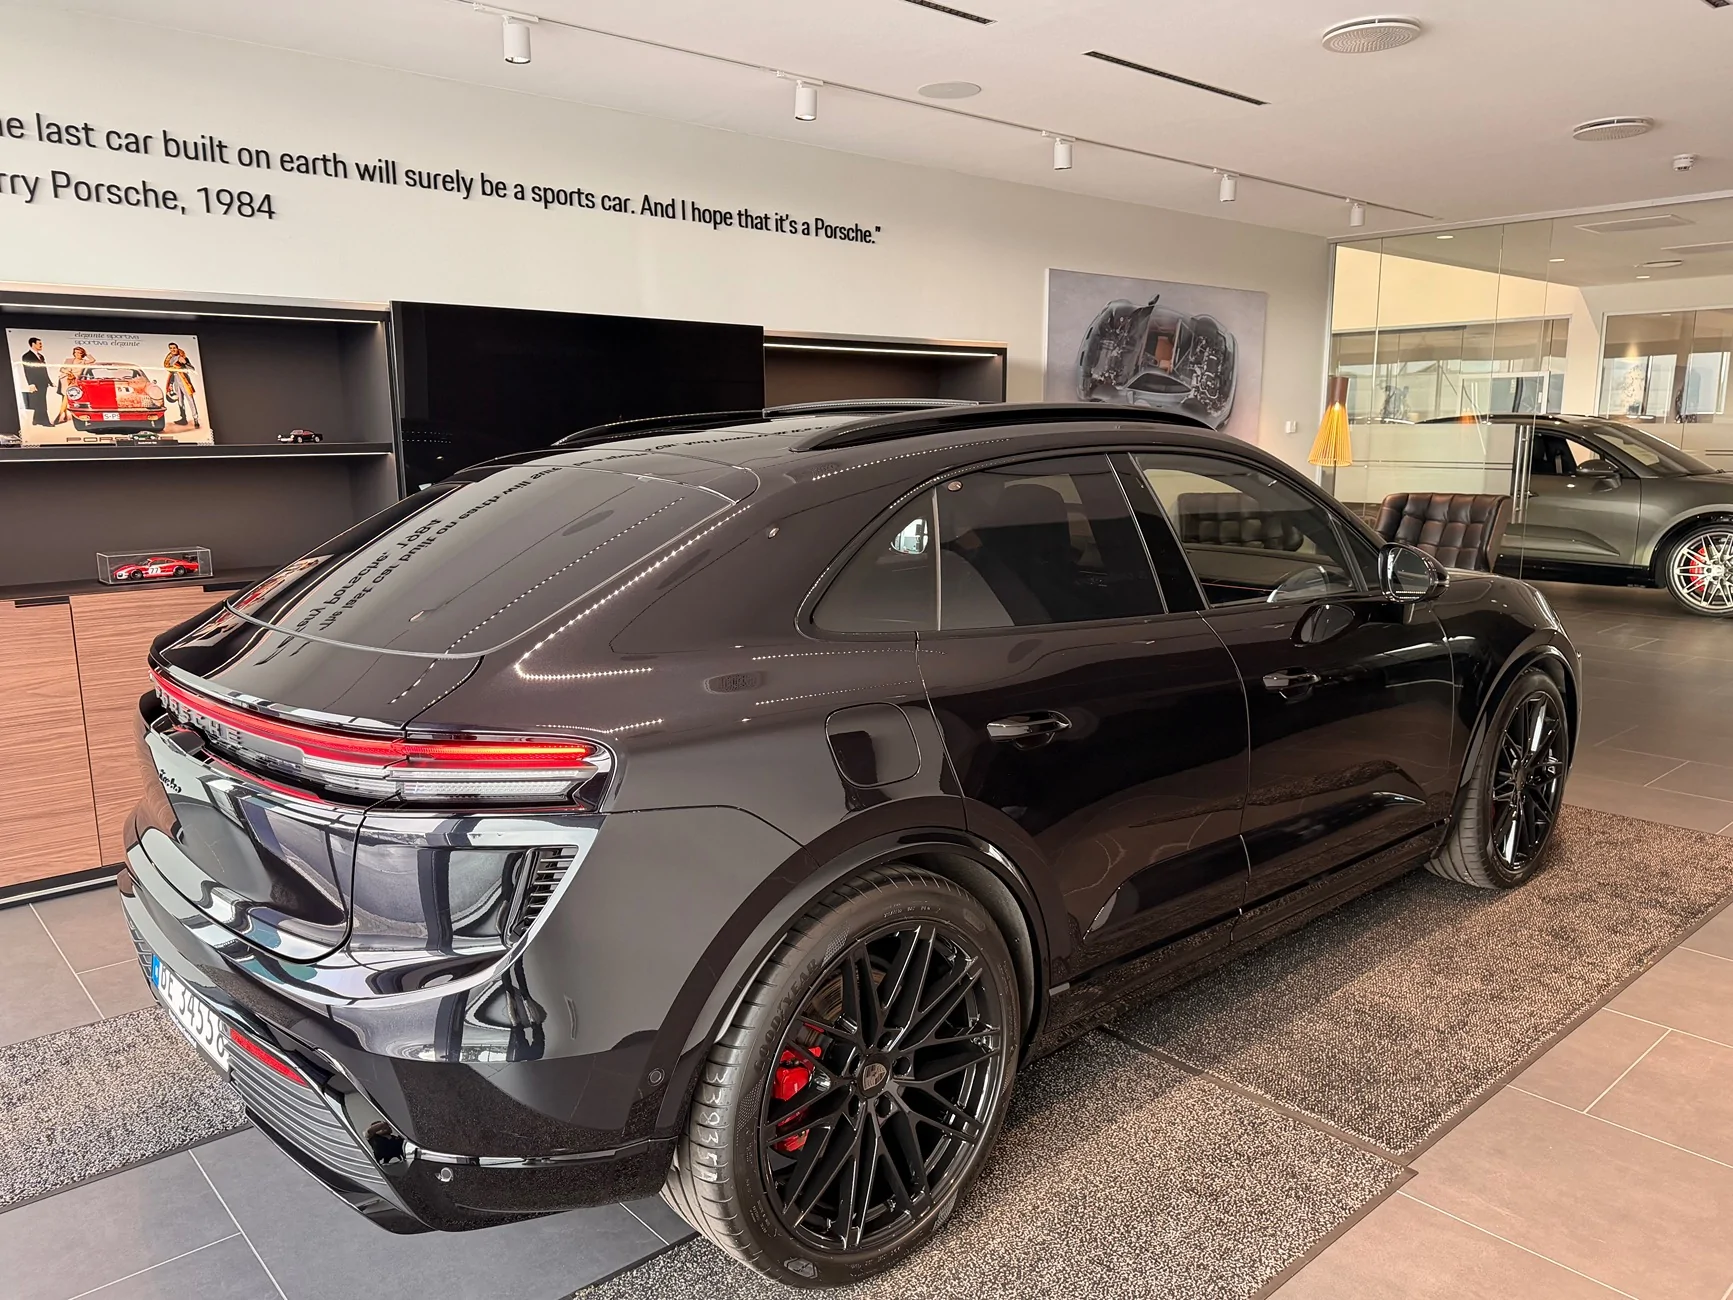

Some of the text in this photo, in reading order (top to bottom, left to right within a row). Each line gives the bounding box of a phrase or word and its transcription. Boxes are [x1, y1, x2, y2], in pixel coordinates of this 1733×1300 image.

[36, 113, 96, 148] last
[106, 130, 153, 155] car
[163, 130, 229, 165] built
[237, 147, 271, 170] on
[280, 152, 347, 179] earth
[355, 158, 397, 185] will
[405, 169, 474, 199] surely
[481, 173, 507, 198] be
[513, 183, 525, 201] a
[531, 185, 596, 209] sports
[601, 194, 635, 215] car.
[640, 194, 676, 220] And
[681, 200, 687, 221] I
[692, 200, 733, 230] hope
[737, 208, 771, 232] that
[775, 212, 798, 235] it's
[801, 221, 811, 237] a
[51, 170, 186, 215] Porsche,
[197, 187, 276, 220] 1984
[754, 958, 819, 1077] GOODYEAR
